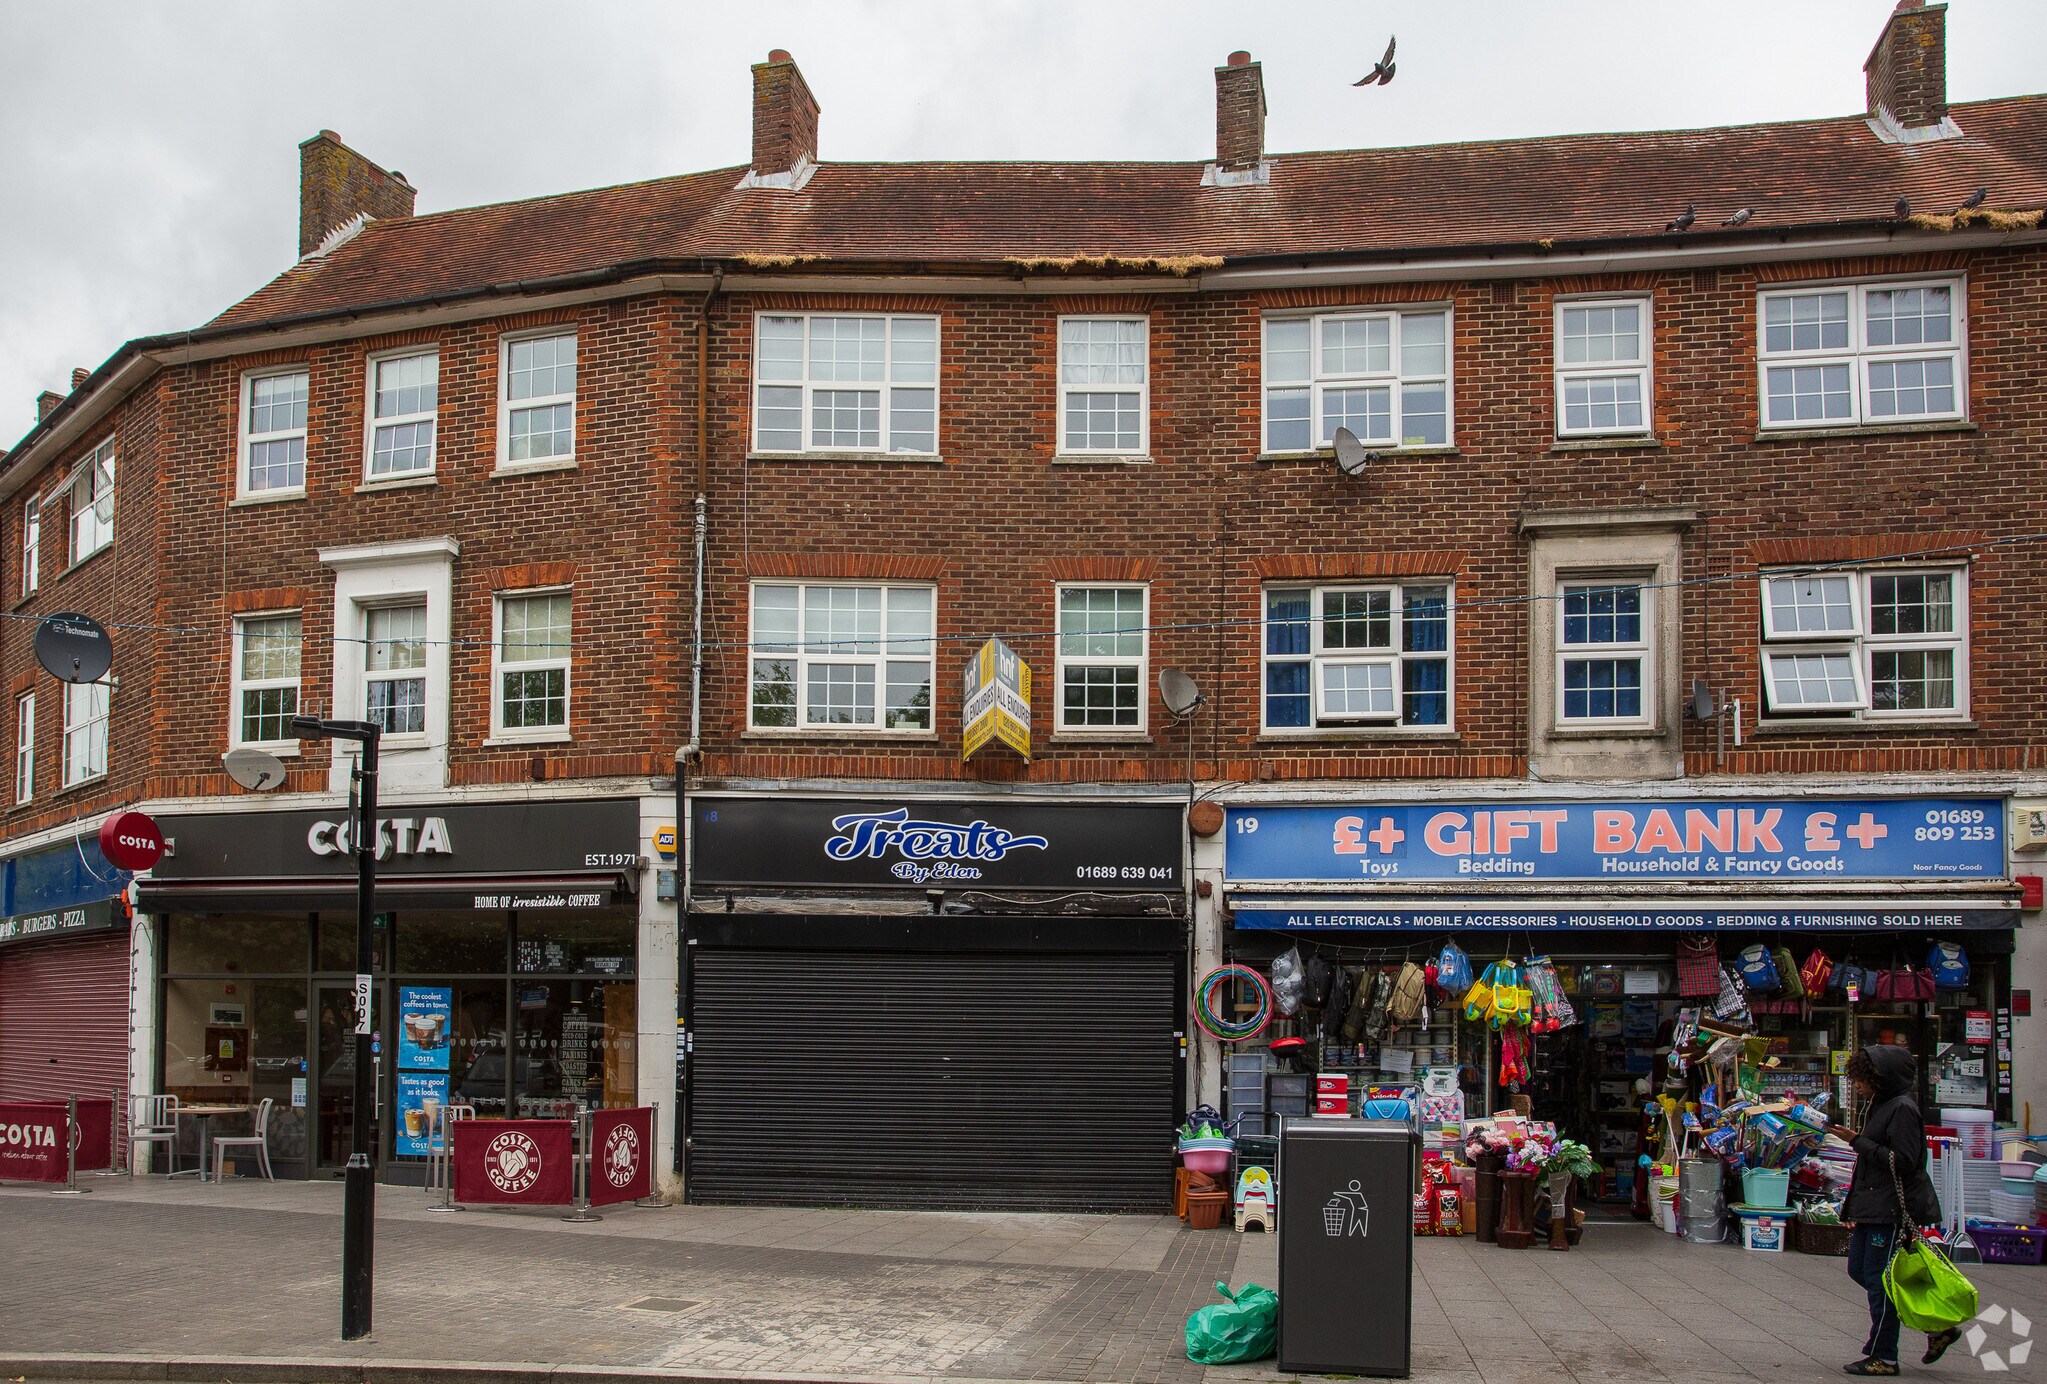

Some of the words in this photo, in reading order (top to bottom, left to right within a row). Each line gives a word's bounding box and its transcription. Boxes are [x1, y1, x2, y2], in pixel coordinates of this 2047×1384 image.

[65, 625, 99, 638] Technomate
[999, 644, 1015, 681] hnf
[997, 685, 1007, 708] ALL
[703, 811, 719, 824] 18
[1925, 809, 1985, 825] 01689
[1235, 817, 1259, 834] 19
[1424, 809, 1568, 855] GIFT
[1592, 808, 1784, 854] BANK
[119, 834, 156, 850] COSTA
[659, 833, 674, 846] ADT
[824, 806, 1048, 862] Treats
[1914, 826, 1955, 842] 809
[1960, 826, 1996, 842] 253
[585, 853, 637, 866] EST.1971
[1601, 856, 1701, 874] Household
[1704, 857, 1721, 872] &
[1724, 856, 1783, 878] Fancy
[1786, 855, 1845, 873] Goods
[890, 862, 930, 884] By
[929, 861, 984, 880] Eden
[1076, 865, 1118, 881] 01689
[1121, 866, 1145, 881] 639
[1149, 866, 1173, 881] 041
[1359, 858, 1400, 880] Toys
[1458, 857, 1537, 879] Bedding
[1912, 862, 1934, 872] Noor
[1935, 862, 1962, 874] Fancy
[1963, 862, 1983, 872] Goods
[474, 895, 499, 909] HOME
[500, 895, 511, 908] OF
[512, 894, 567, 909] irresistible
[568, 894, 601, 908] COFFEE
[22, 914, 57, 934] BURGERS
[63, 909, 86, 928] PIZZA
[1287, 915, 1312, 928] ALL
[1315, 915, 1401, 928] ELECTRICALS
[1413, 915, 1462, 928] MOBILE
[1464, 915, 1558, 928] ACCESSORIES
[1570, 914, 1652, 927] HOUSEHOLD
[1655, 914, 1704, 927] GOODS
[1717, 914, 1777, 927] BEDDING
[1780, 914, 1791, 927] &
[1794, 914, 1878, 927] FURNISHING
[1883, 914, 1921, 926] SOLD
[1924, 914, 1963, 926] HERE
[409, 991, 421, 1000] The
[421, 992, 442, 1001] coolest
[403, 1000, 425, 1008] coffees
[432, 1001, 450, 1009] town.
[562, 1021, 588, 1030] COFFEE
[562, 1039, 588, 1048] DRINKS
[575, 1032, 588, 1040] COLD
[562, 1050, 588, 1059] PANINIS
[1967, 1066, 1981, 1074] £5
[401, 1076, 419, 1085] Tastes
[428, 1077, 445, 1088] good
[415, 1088, 421, 1096] it
[421, 1087, 440, 1096] looks.
[0, 1123, 56, 1149] COSTA
[492, 1133, 534, 1153] COSTA
[607, 1126, 638, 1152] COFFEE
[489, 1168, 538, 1191] COFFEE
[609, 1164, 635, 1186] COSTA
